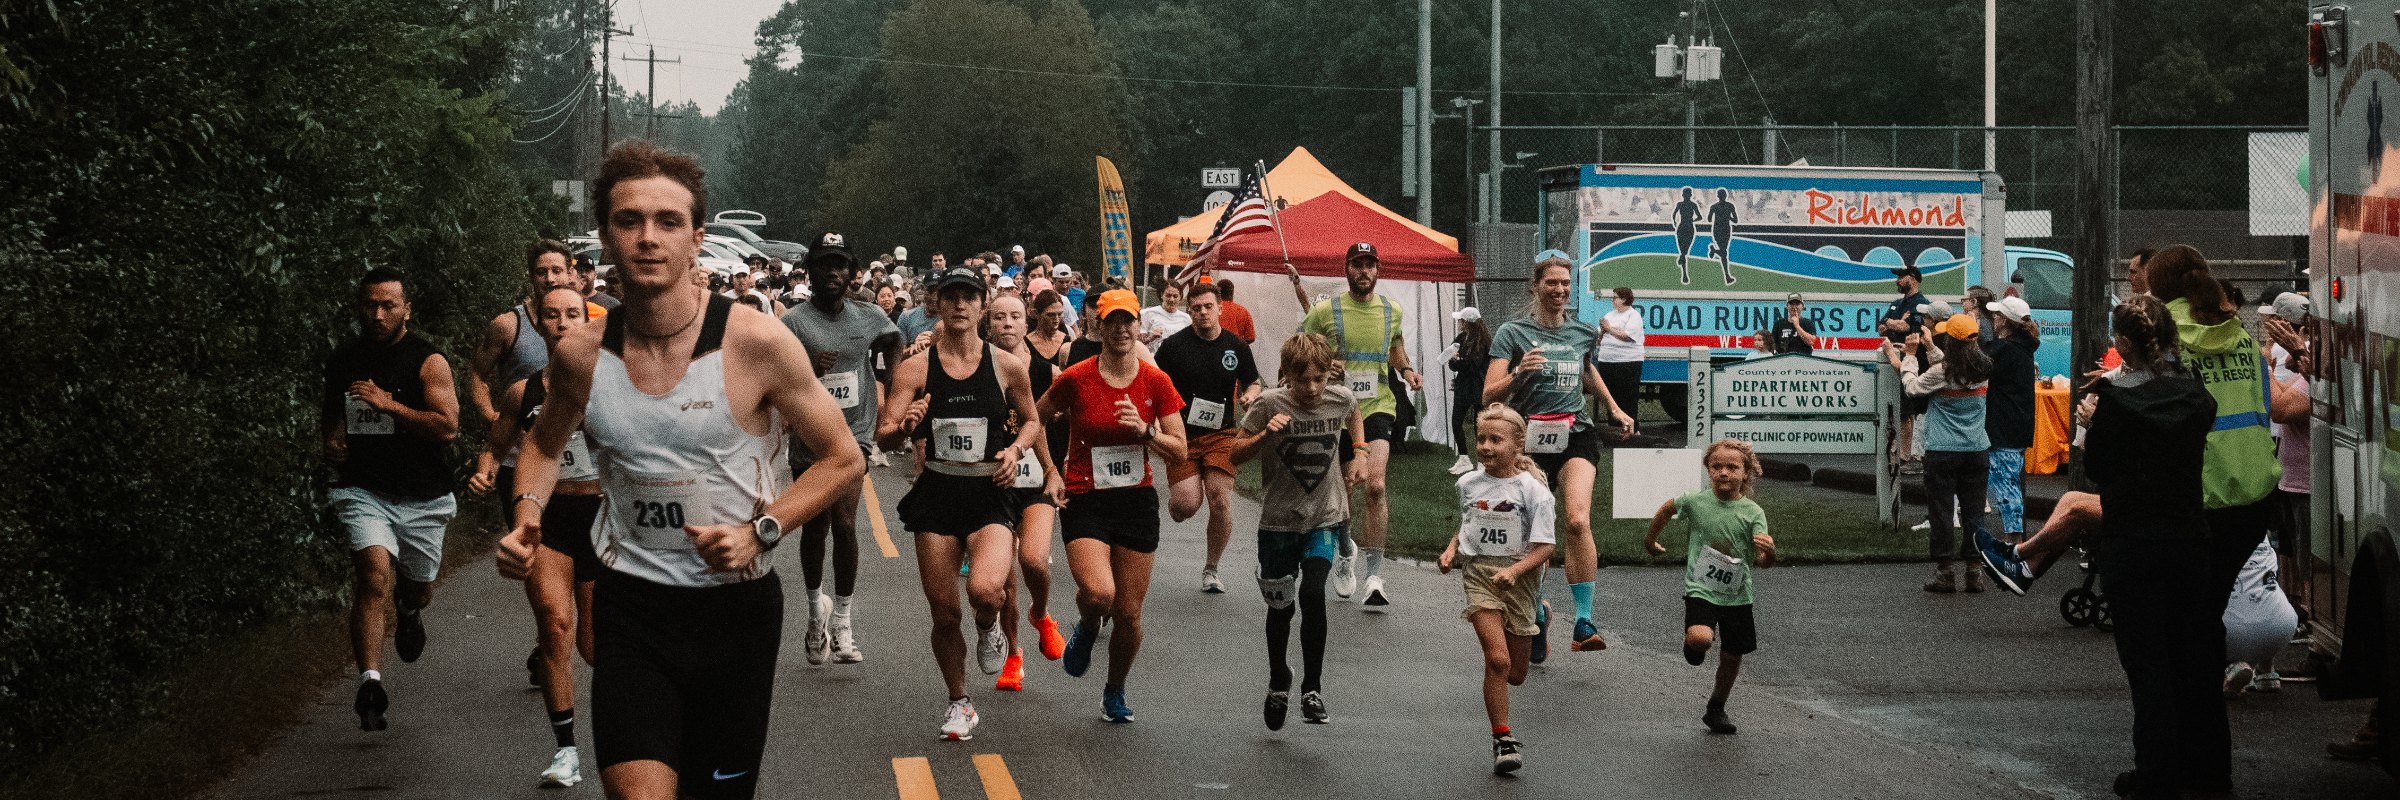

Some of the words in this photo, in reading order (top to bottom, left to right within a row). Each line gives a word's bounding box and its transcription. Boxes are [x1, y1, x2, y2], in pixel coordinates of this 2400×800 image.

[1206, 171, 1236, 184] EAST
[1805, 189, 1966, 226] Richmond
[2041, 327, 2060, 336] ROAD
[1719, 336, 1743, 348] WE
[1738, 369, 1777, 377] County
[2213, 371, 2220, 383] &
[1353, 381, 1371, 392] 236
[1732, 380, 1828, 393] DEPARTMENT
[1834, 380, 1853, 393] OF
[1727, 396, 1788, 408] PUBLIC
[1796, 395, 1858, 408] WORKS
[1198, 410, 1216, 422] 237
[1293, 419, 1326, 434] SUPER
[948, 434, 973, 451] 195
[1538, 434, 1558, 445] 247
[1751, 432, 1785, 442] CLINIC
[1788, 432, 1801, 442] OF
[1803, 432, 1864, 442] POWHATAN
[1107, 460, 1131, 476] 186
[633, 500, 685, 529] 230
[1480, 527, 1507, 545] 245
[1705, 565, 1733, 584] 246
